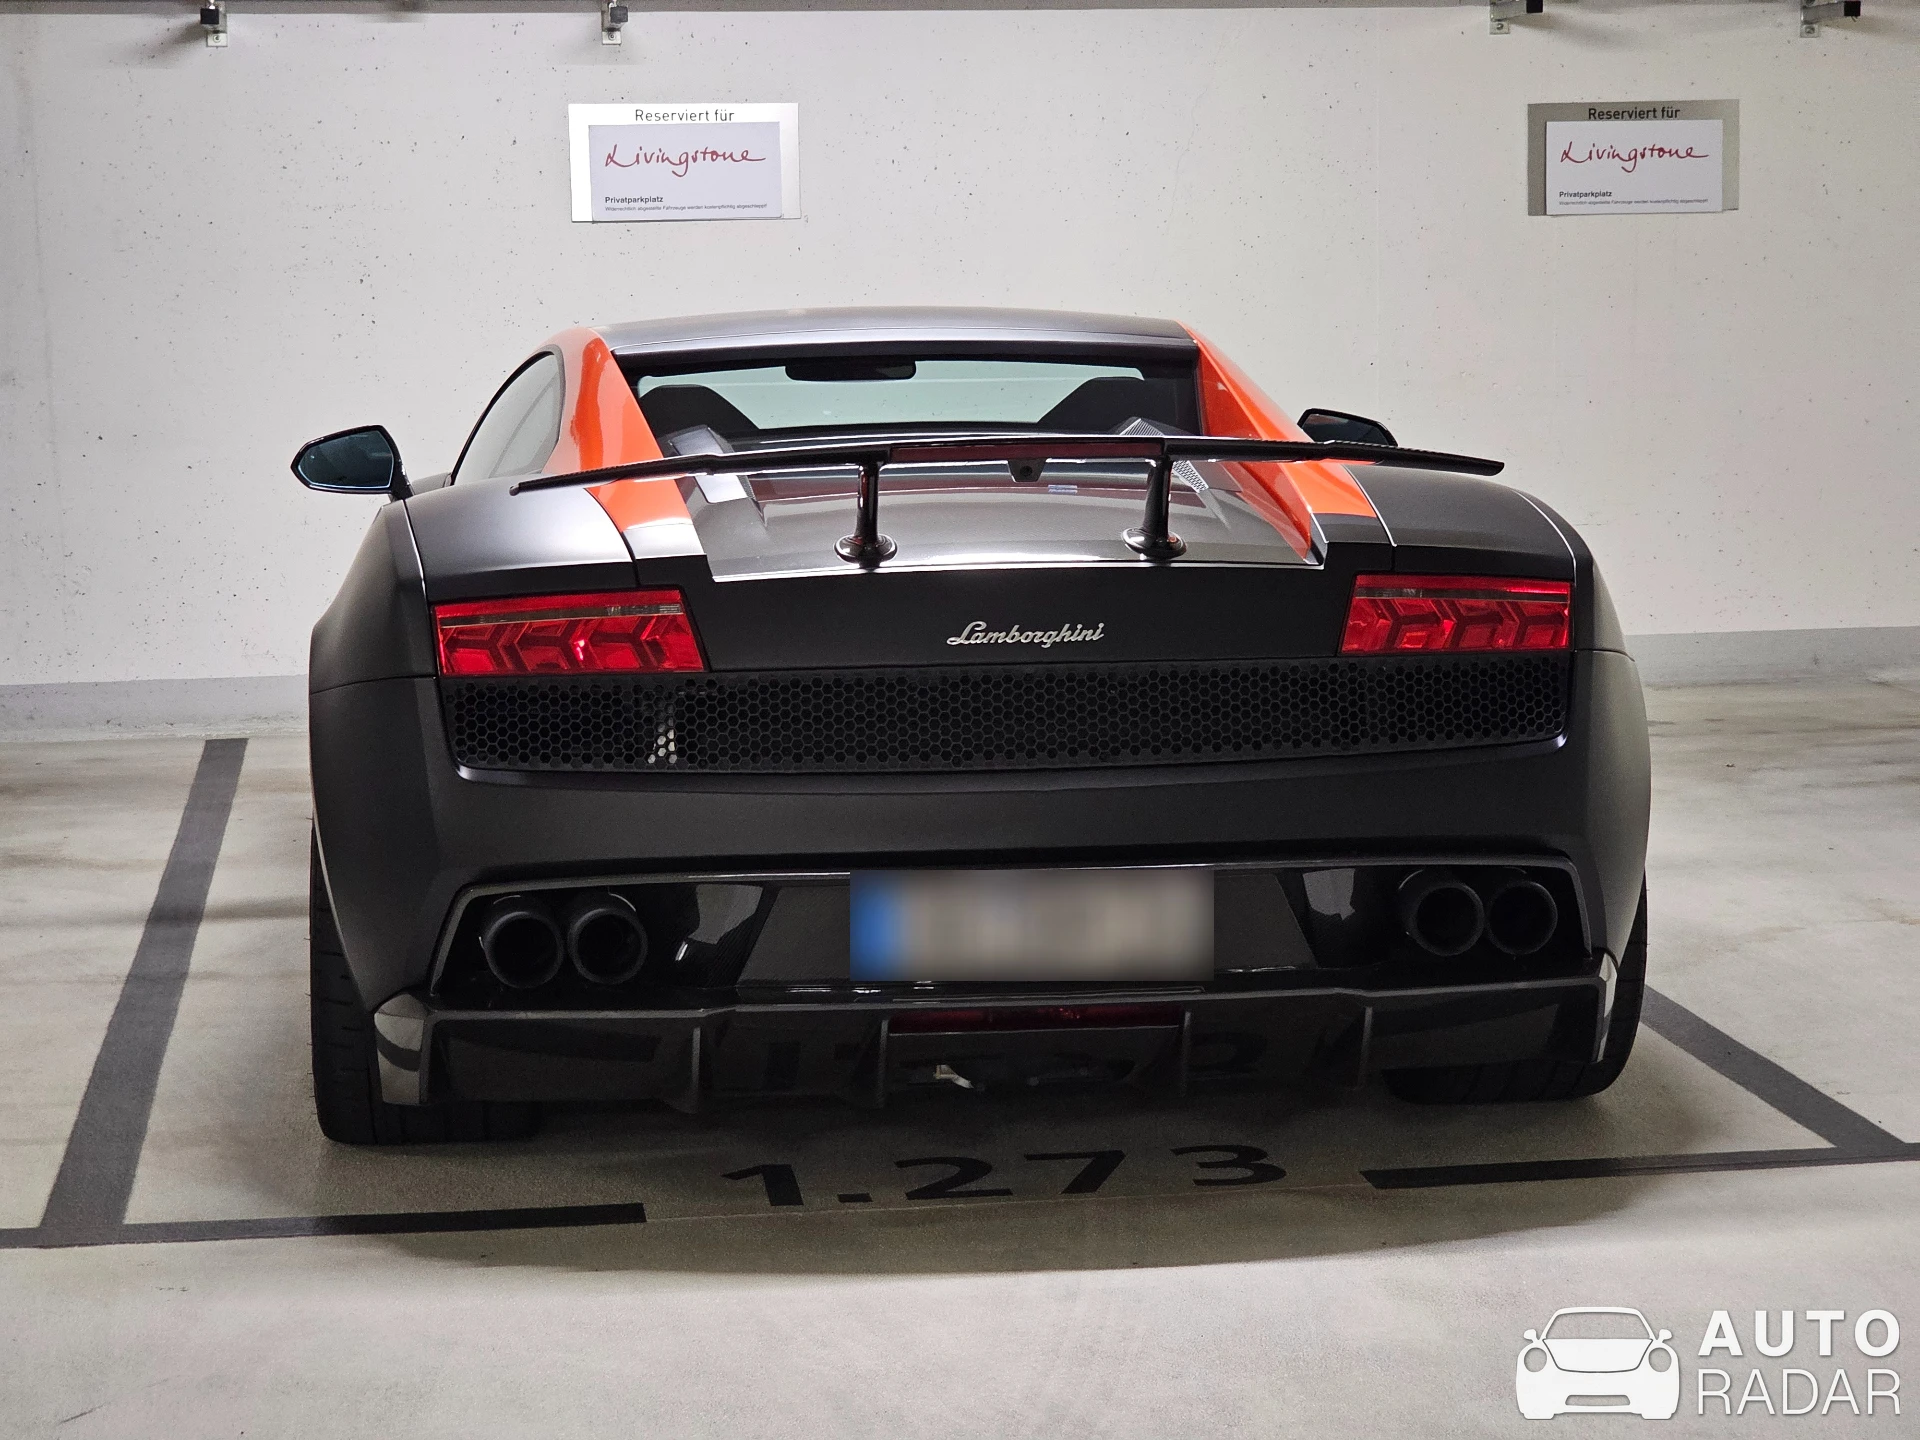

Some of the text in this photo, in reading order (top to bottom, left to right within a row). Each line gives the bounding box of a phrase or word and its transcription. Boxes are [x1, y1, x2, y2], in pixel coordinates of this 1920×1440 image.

[635, 109, 735, 122] Reserviert für
[1588, 106, 1680, 120] Reserviert für
[605, 144, 766, 177] Livingstone
[1560, 141, 1709, 173] Livingstone
[604, 195, 664, 205] Privatparkplatz
[1559, 190, 1613, 199] Privatparkplatz
[946, 620, 1105, 649] Lamborghini
[721, 1144, 1288, 1207] 1.273
